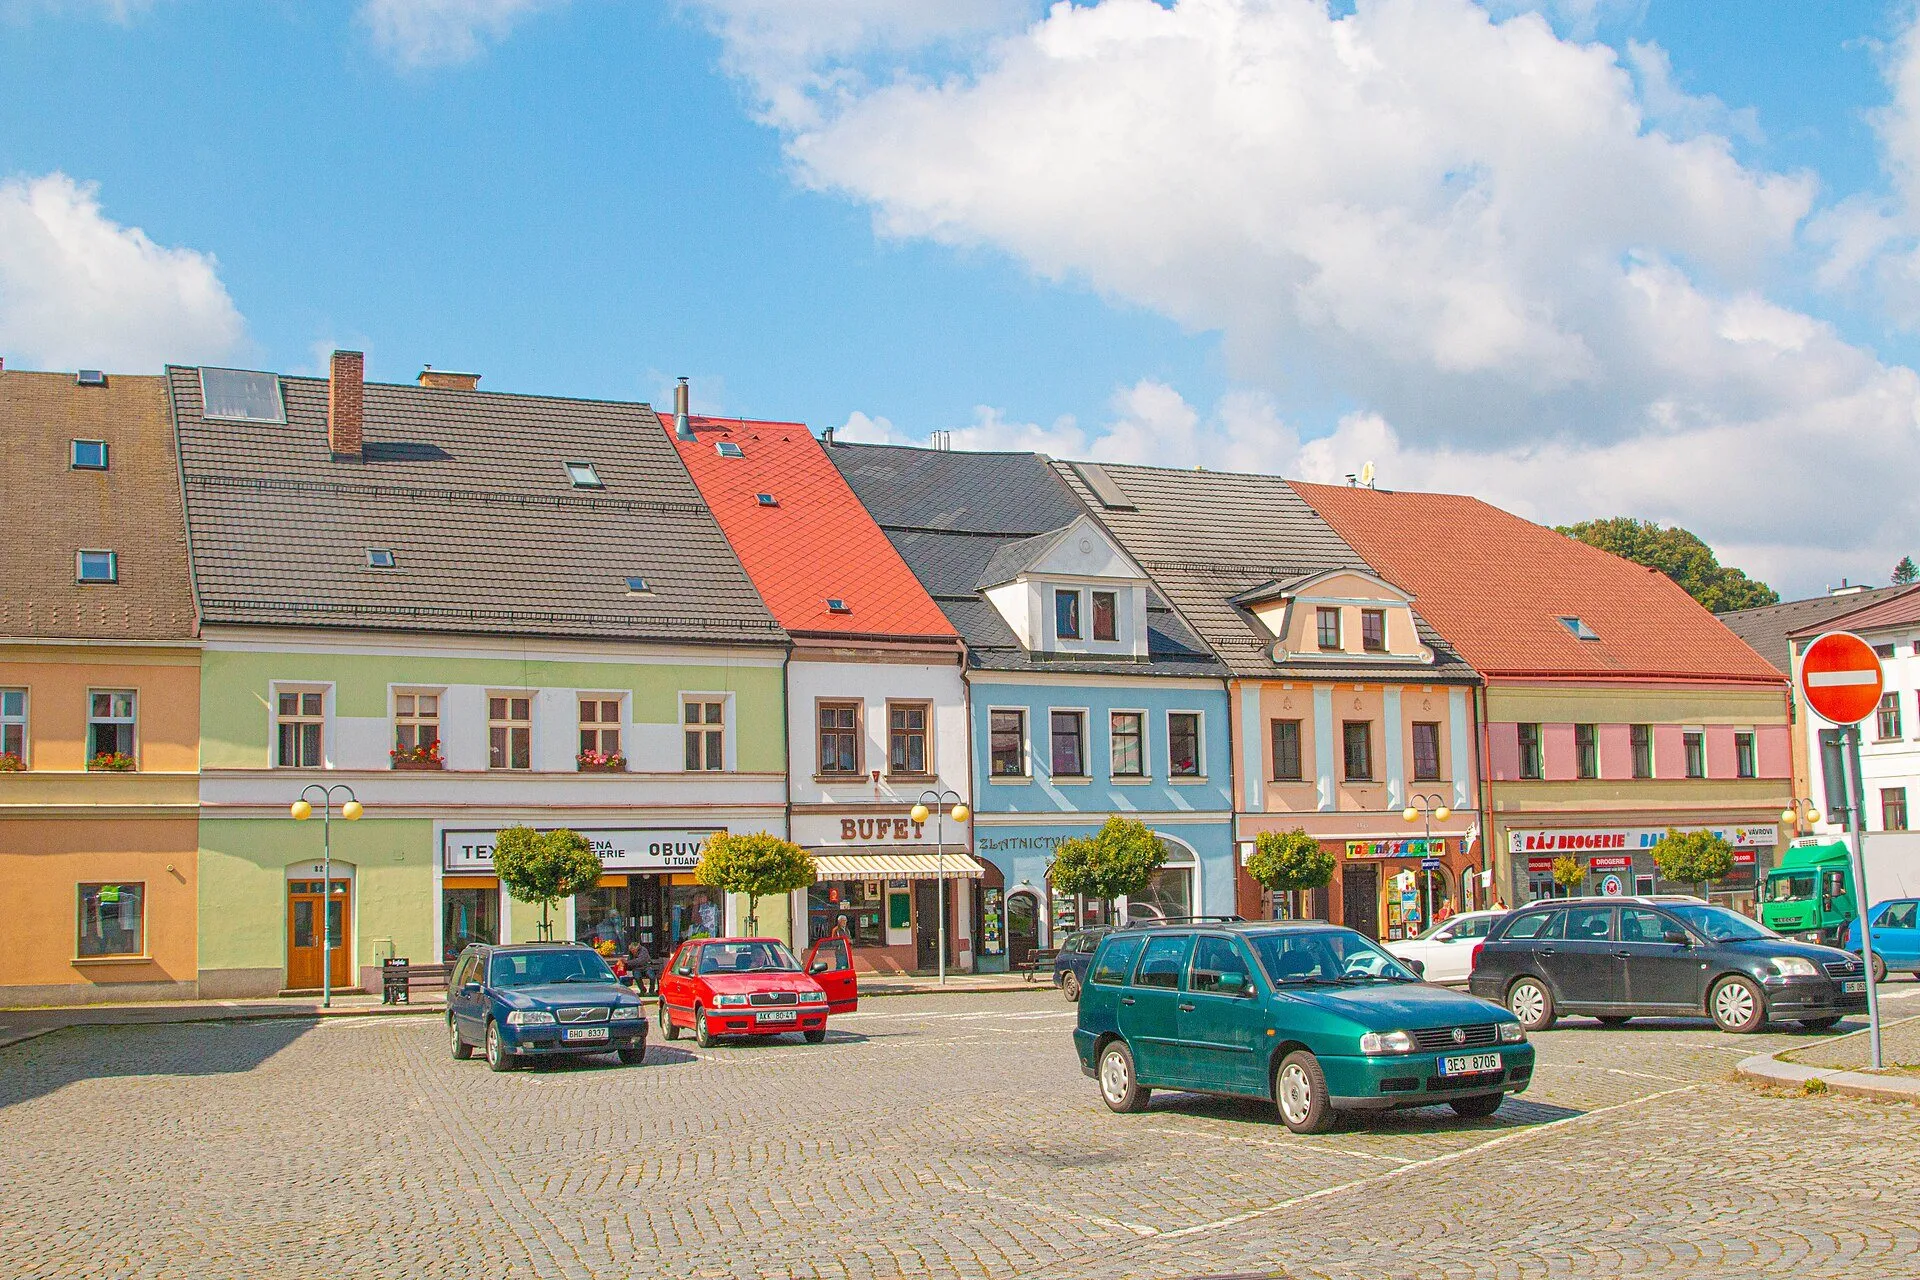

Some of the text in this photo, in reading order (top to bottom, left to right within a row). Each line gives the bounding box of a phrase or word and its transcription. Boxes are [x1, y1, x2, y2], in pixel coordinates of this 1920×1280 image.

[841, 818, 924, 840] BUFET
[1526, 832, 1625, 850] RÁJ DROGERIE
[649, 842, 701, 856] OBUV
[1348, 842, 1390, 855] TOČENÁ
[664, 857, 670, 865] U
[588, 1029, 605, 1037] 8337
[1447, 1055, 1496, 1071] 3E3 8706
